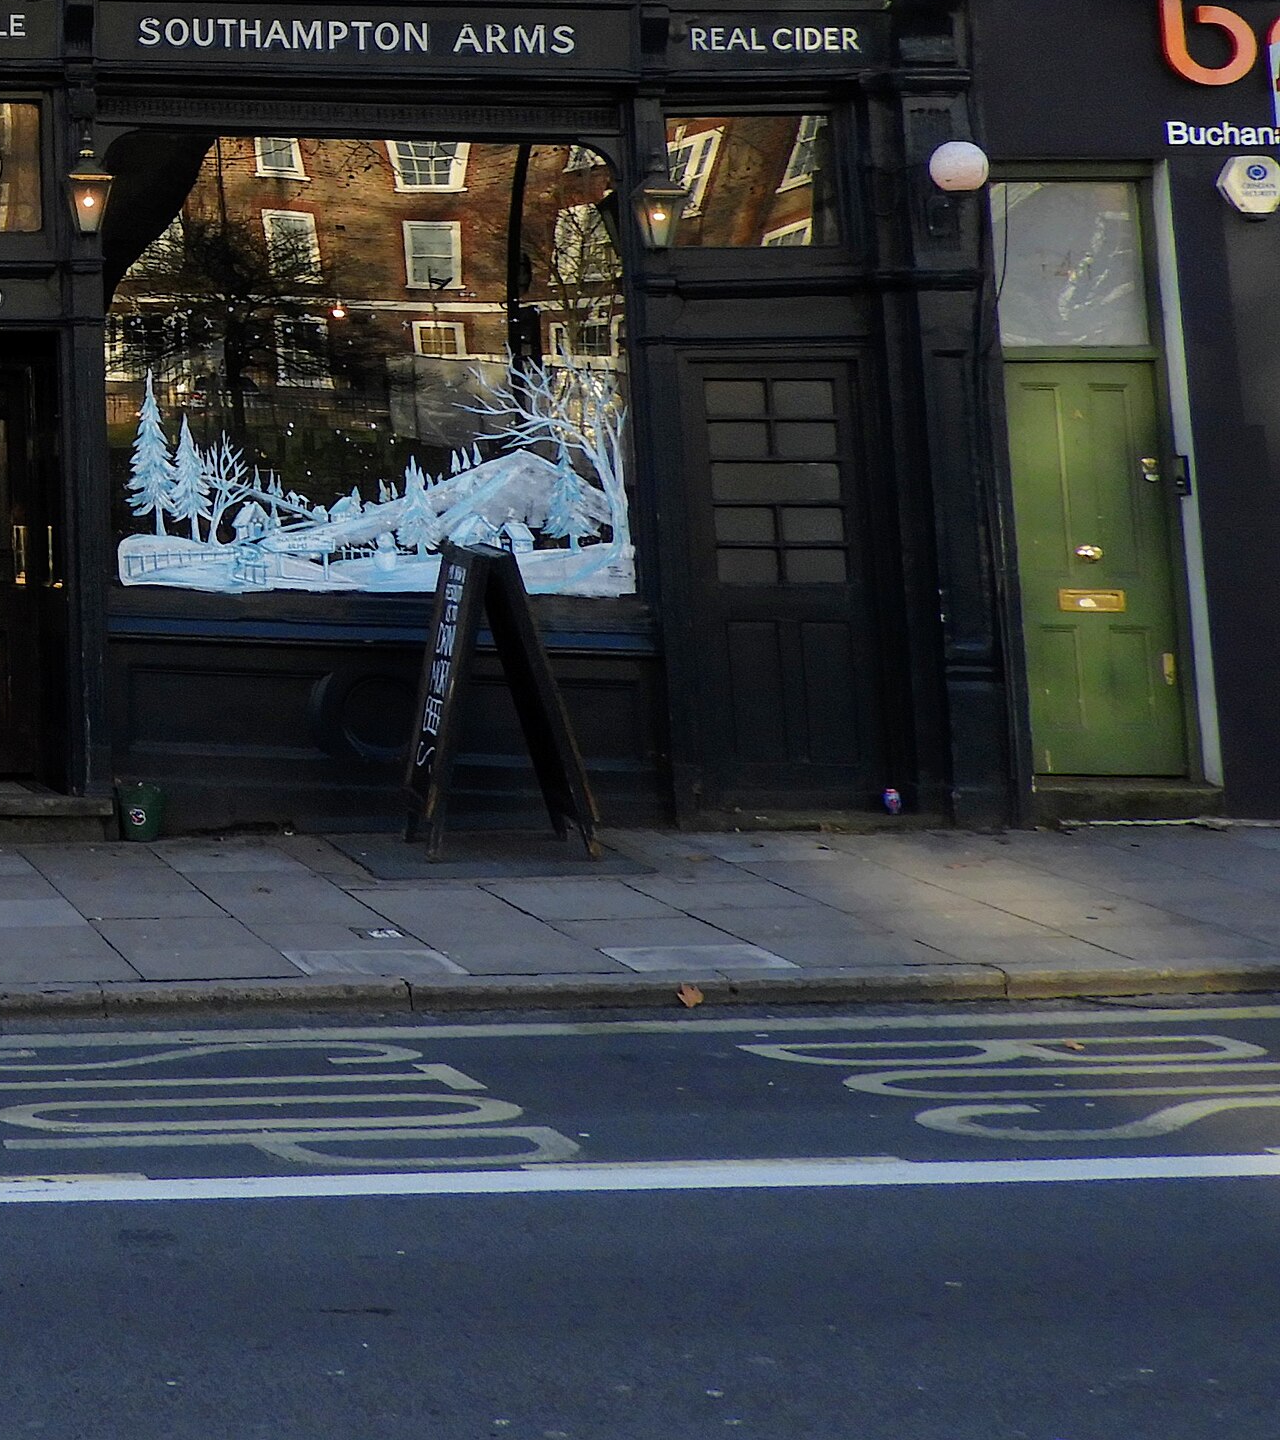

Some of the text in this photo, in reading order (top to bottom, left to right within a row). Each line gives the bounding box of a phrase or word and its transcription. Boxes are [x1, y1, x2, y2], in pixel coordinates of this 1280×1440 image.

[137, 16, 576, 55] SOUTHAMPTON ARMS
[690, 26, 860, 52] REAL CIDER
